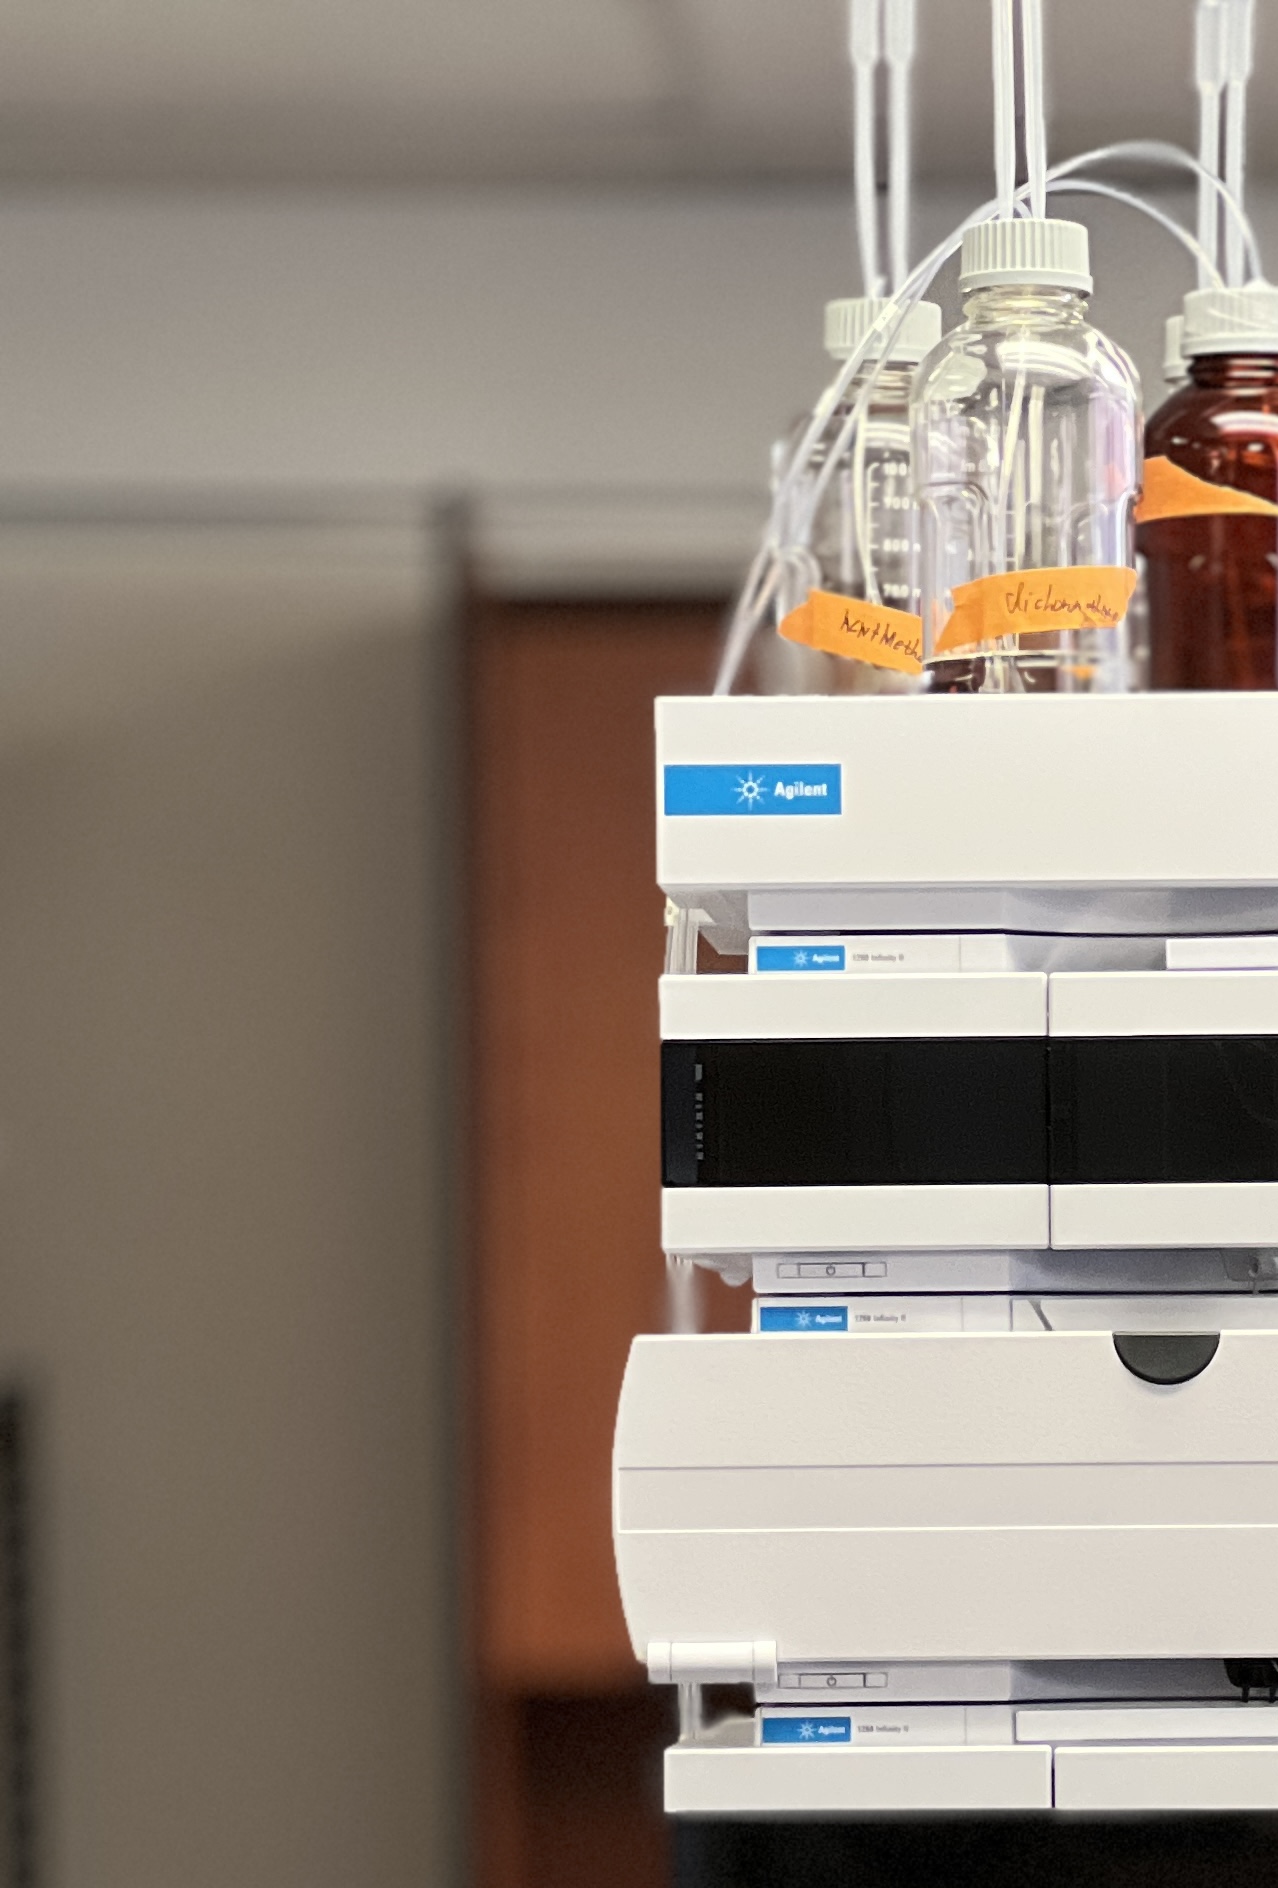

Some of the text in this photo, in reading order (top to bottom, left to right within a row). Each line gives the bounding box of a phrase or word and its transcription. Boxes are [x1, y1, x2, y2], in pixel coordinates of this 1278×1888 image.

[774, 781, 828, 800] Agilent
[812, 953, 840, 964] Agilent
[815, 1314, 843, 1325] Agilent
[818, 1725, 846, 1736] Agilent
